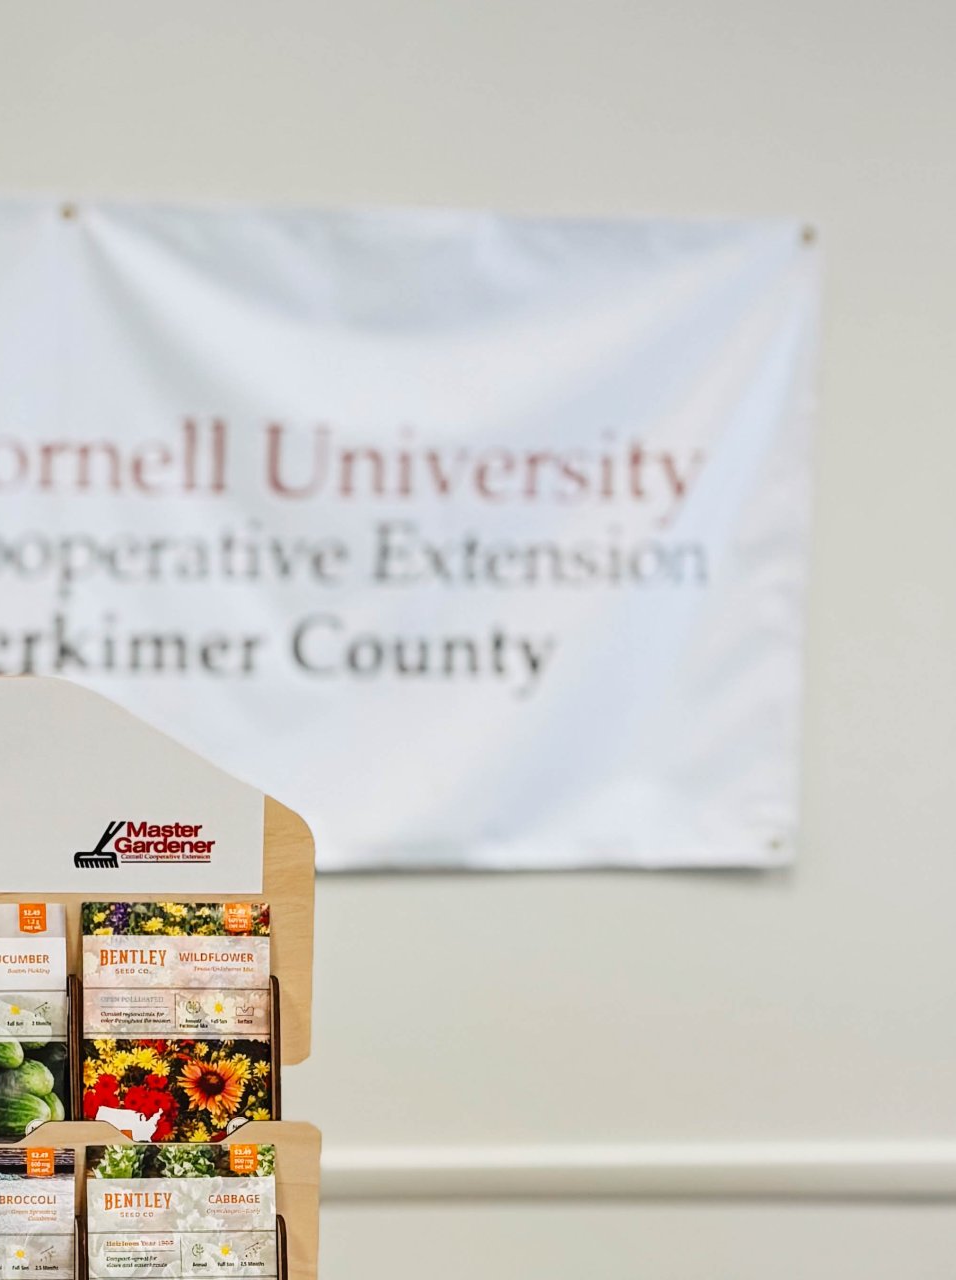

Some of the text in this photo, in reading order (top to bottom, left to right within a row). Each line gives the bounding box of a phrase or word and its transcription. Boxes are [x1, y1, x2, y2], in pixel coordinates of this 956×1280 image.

[261, 420, 704, 526] University
[372, 518, 708, 586] Extension
[291, 615, 557, 692] County
[127, 822, 203, 838] Master
[115, 837, 215, 853] Gardener
[100, 950, 166, 966] BENTLEY
[179, 953, 253, 962] WILDFLOWER
[0, 1196, 56, 1204] BROCCOLI
[104, 1193, 172, 1210] BENTLEY
[209, 1195, 260, 1203] CABBAGE
